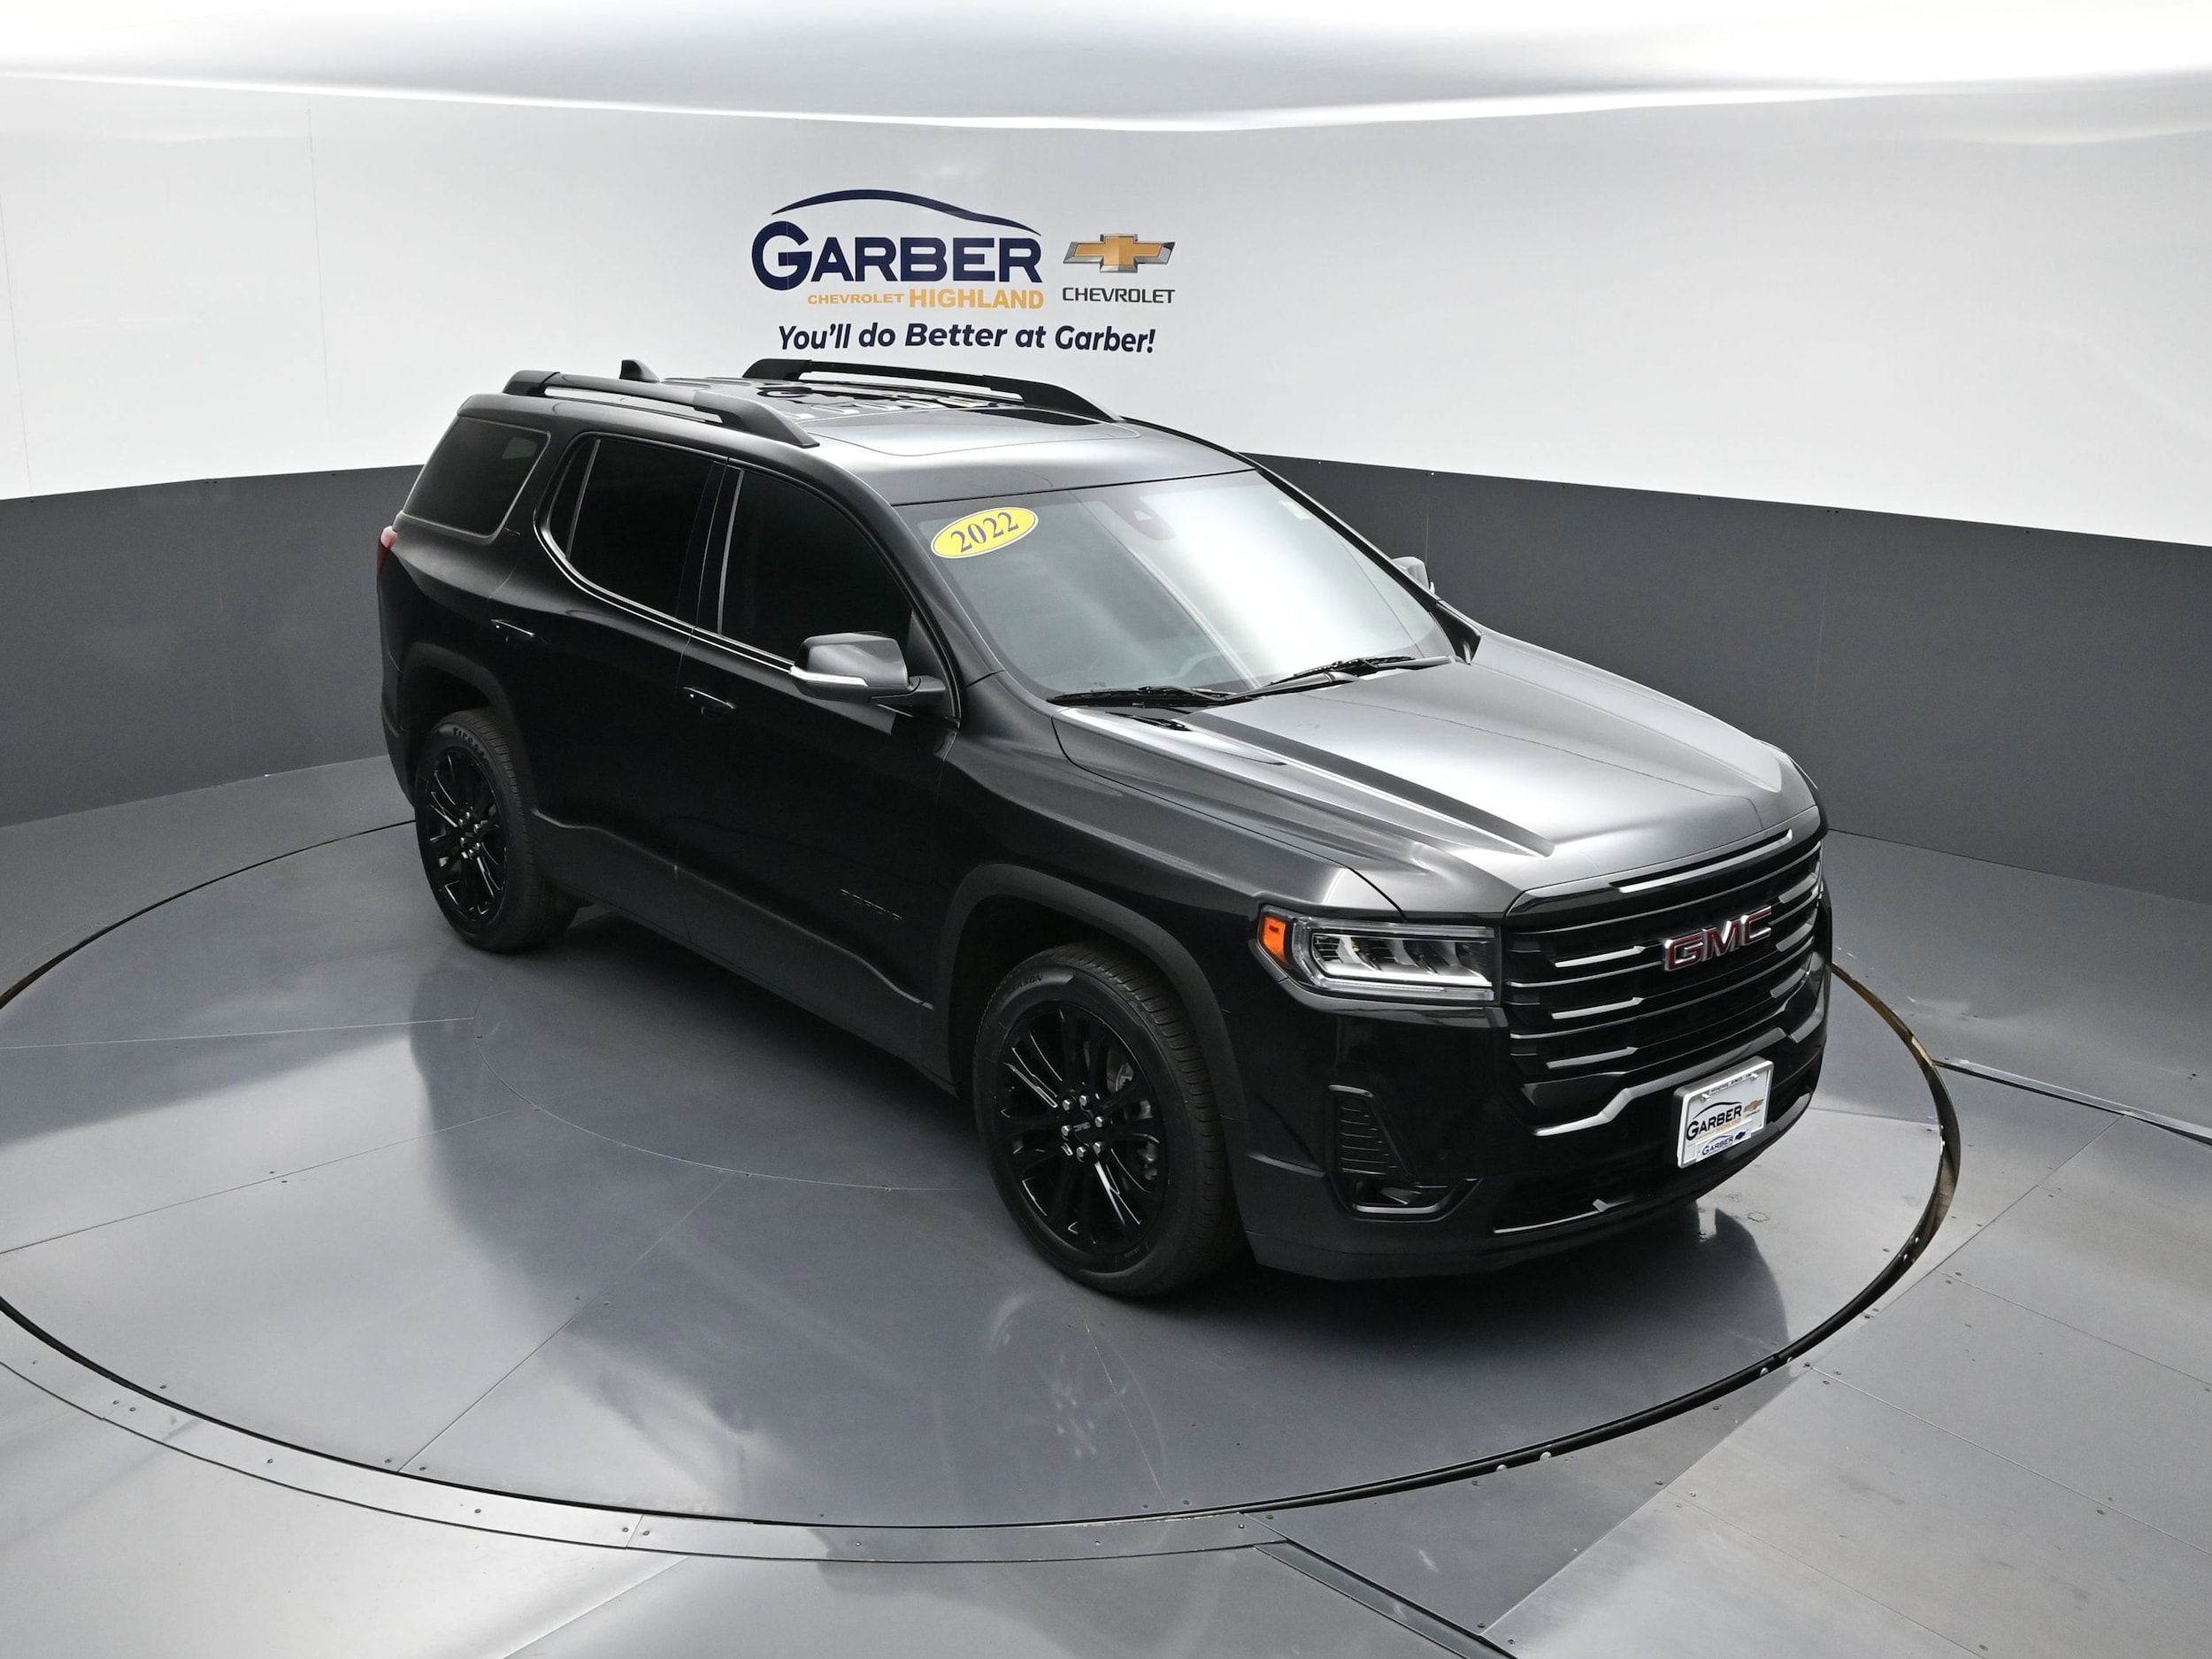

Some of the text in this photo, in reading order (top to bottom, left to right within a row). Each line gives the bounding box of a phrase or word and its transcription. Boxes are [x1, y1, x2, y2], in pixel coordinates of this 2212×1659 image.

[751, 220, 1043, 290] GARBER
[807, 288, 1044, 310] CHEVROLET HIGHLAND
[1062, 287, 1176, 304] CHEVROLET
[779, 321, 1156, 354] You'll do Better at Garber!
[951, 512, 1018, 553] 2022
[1663, 905, 1771, 972] GMC
[1686, 1105, 1743, 1141] GARBER
[1701, 1136, 1734, 1156] GARBER
